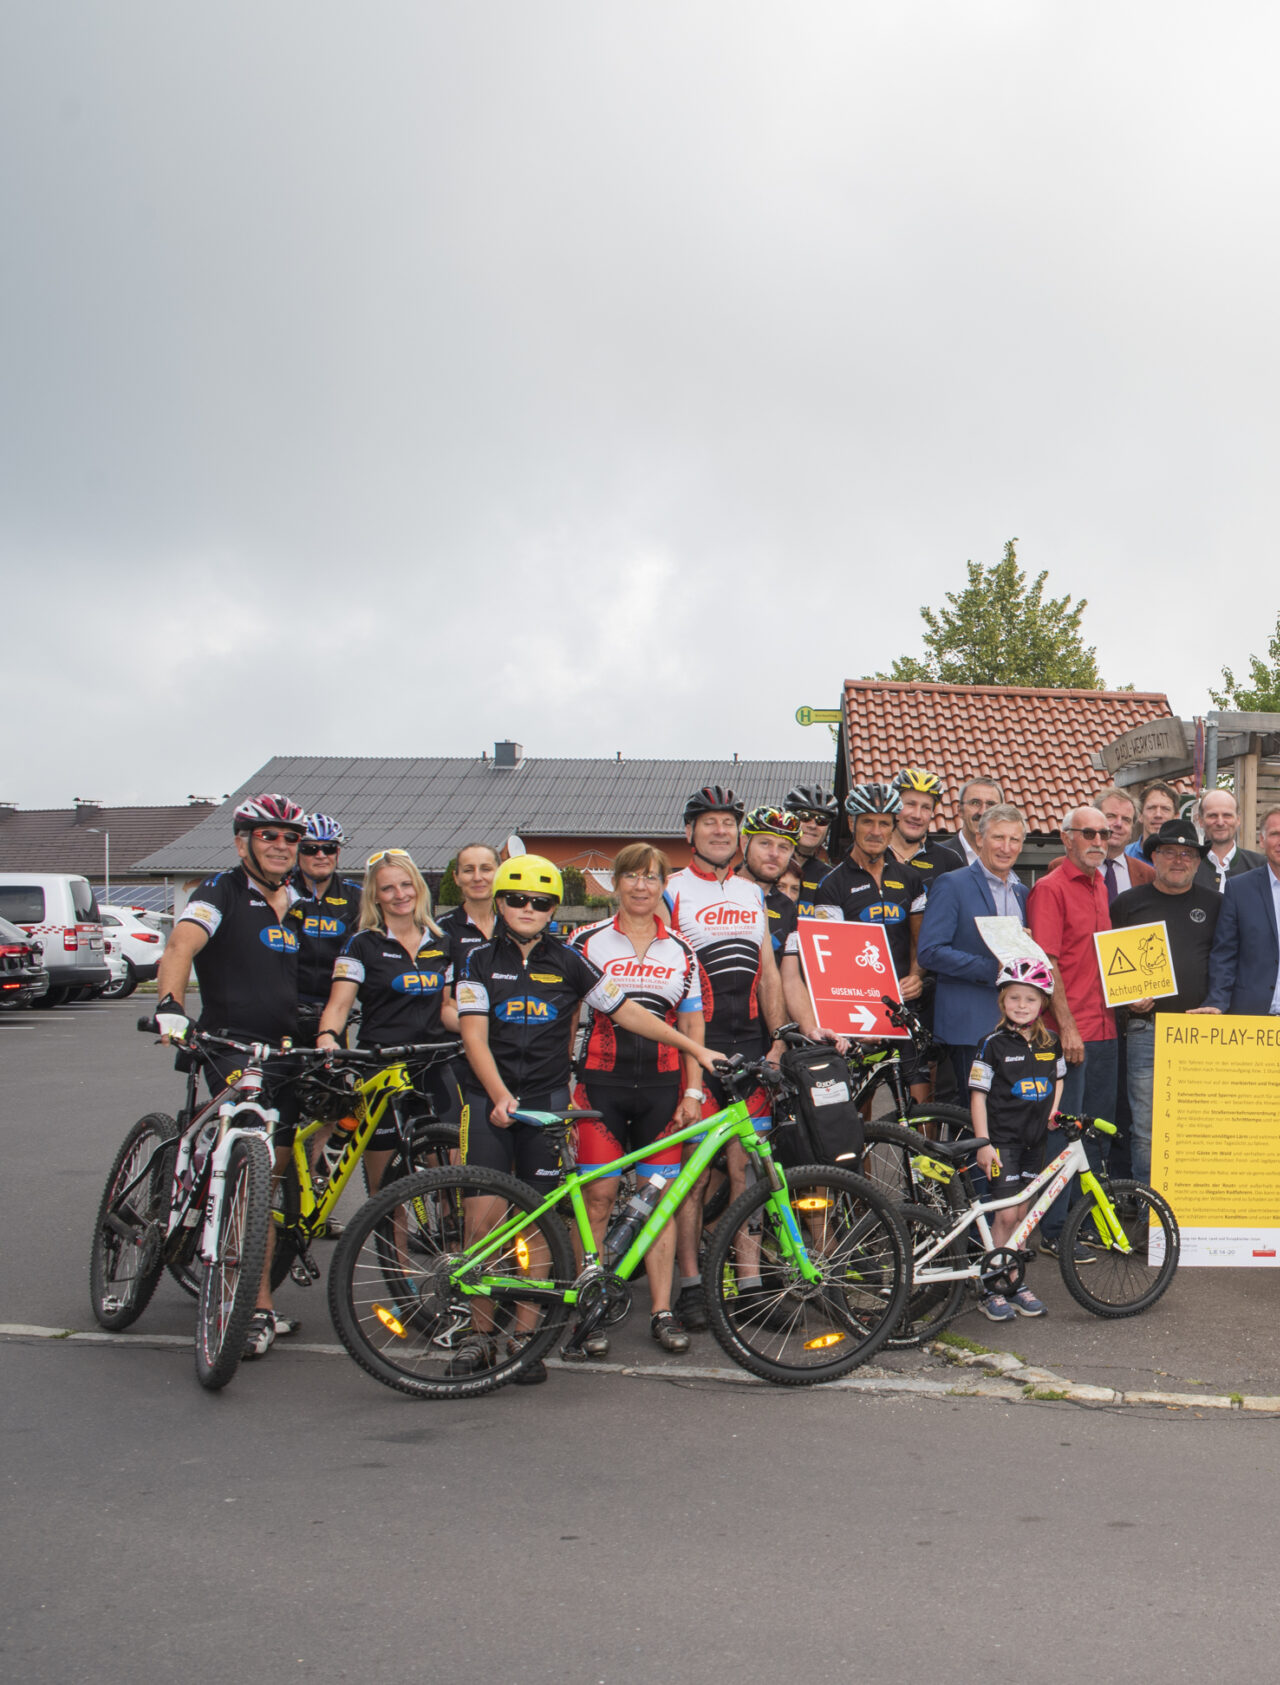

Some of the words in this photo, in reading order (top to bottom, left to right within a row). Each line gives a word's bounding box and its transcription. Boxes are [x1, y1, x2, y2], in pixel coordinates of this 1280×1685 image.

[801, 710, 811, 722] H
[704, 907, 758, 925] elmer
[798, 906, 815, 916] M
[869, 906, 899, 919] PM
[304, 918, 338, 932] PM
[268, 929, 296, 946] PM
[812, 934, 832, 973] F
[611, 961, 676, 979] elmer
[403, 974, 438, 988] PM
[1109, 983, 1143, 997] Achtung
[1143, 978, 1171, 989] Pferde
[831, 987, 881, 998] GUSENTAL-SÜD
[506, 1001, 548, 1016] PM
